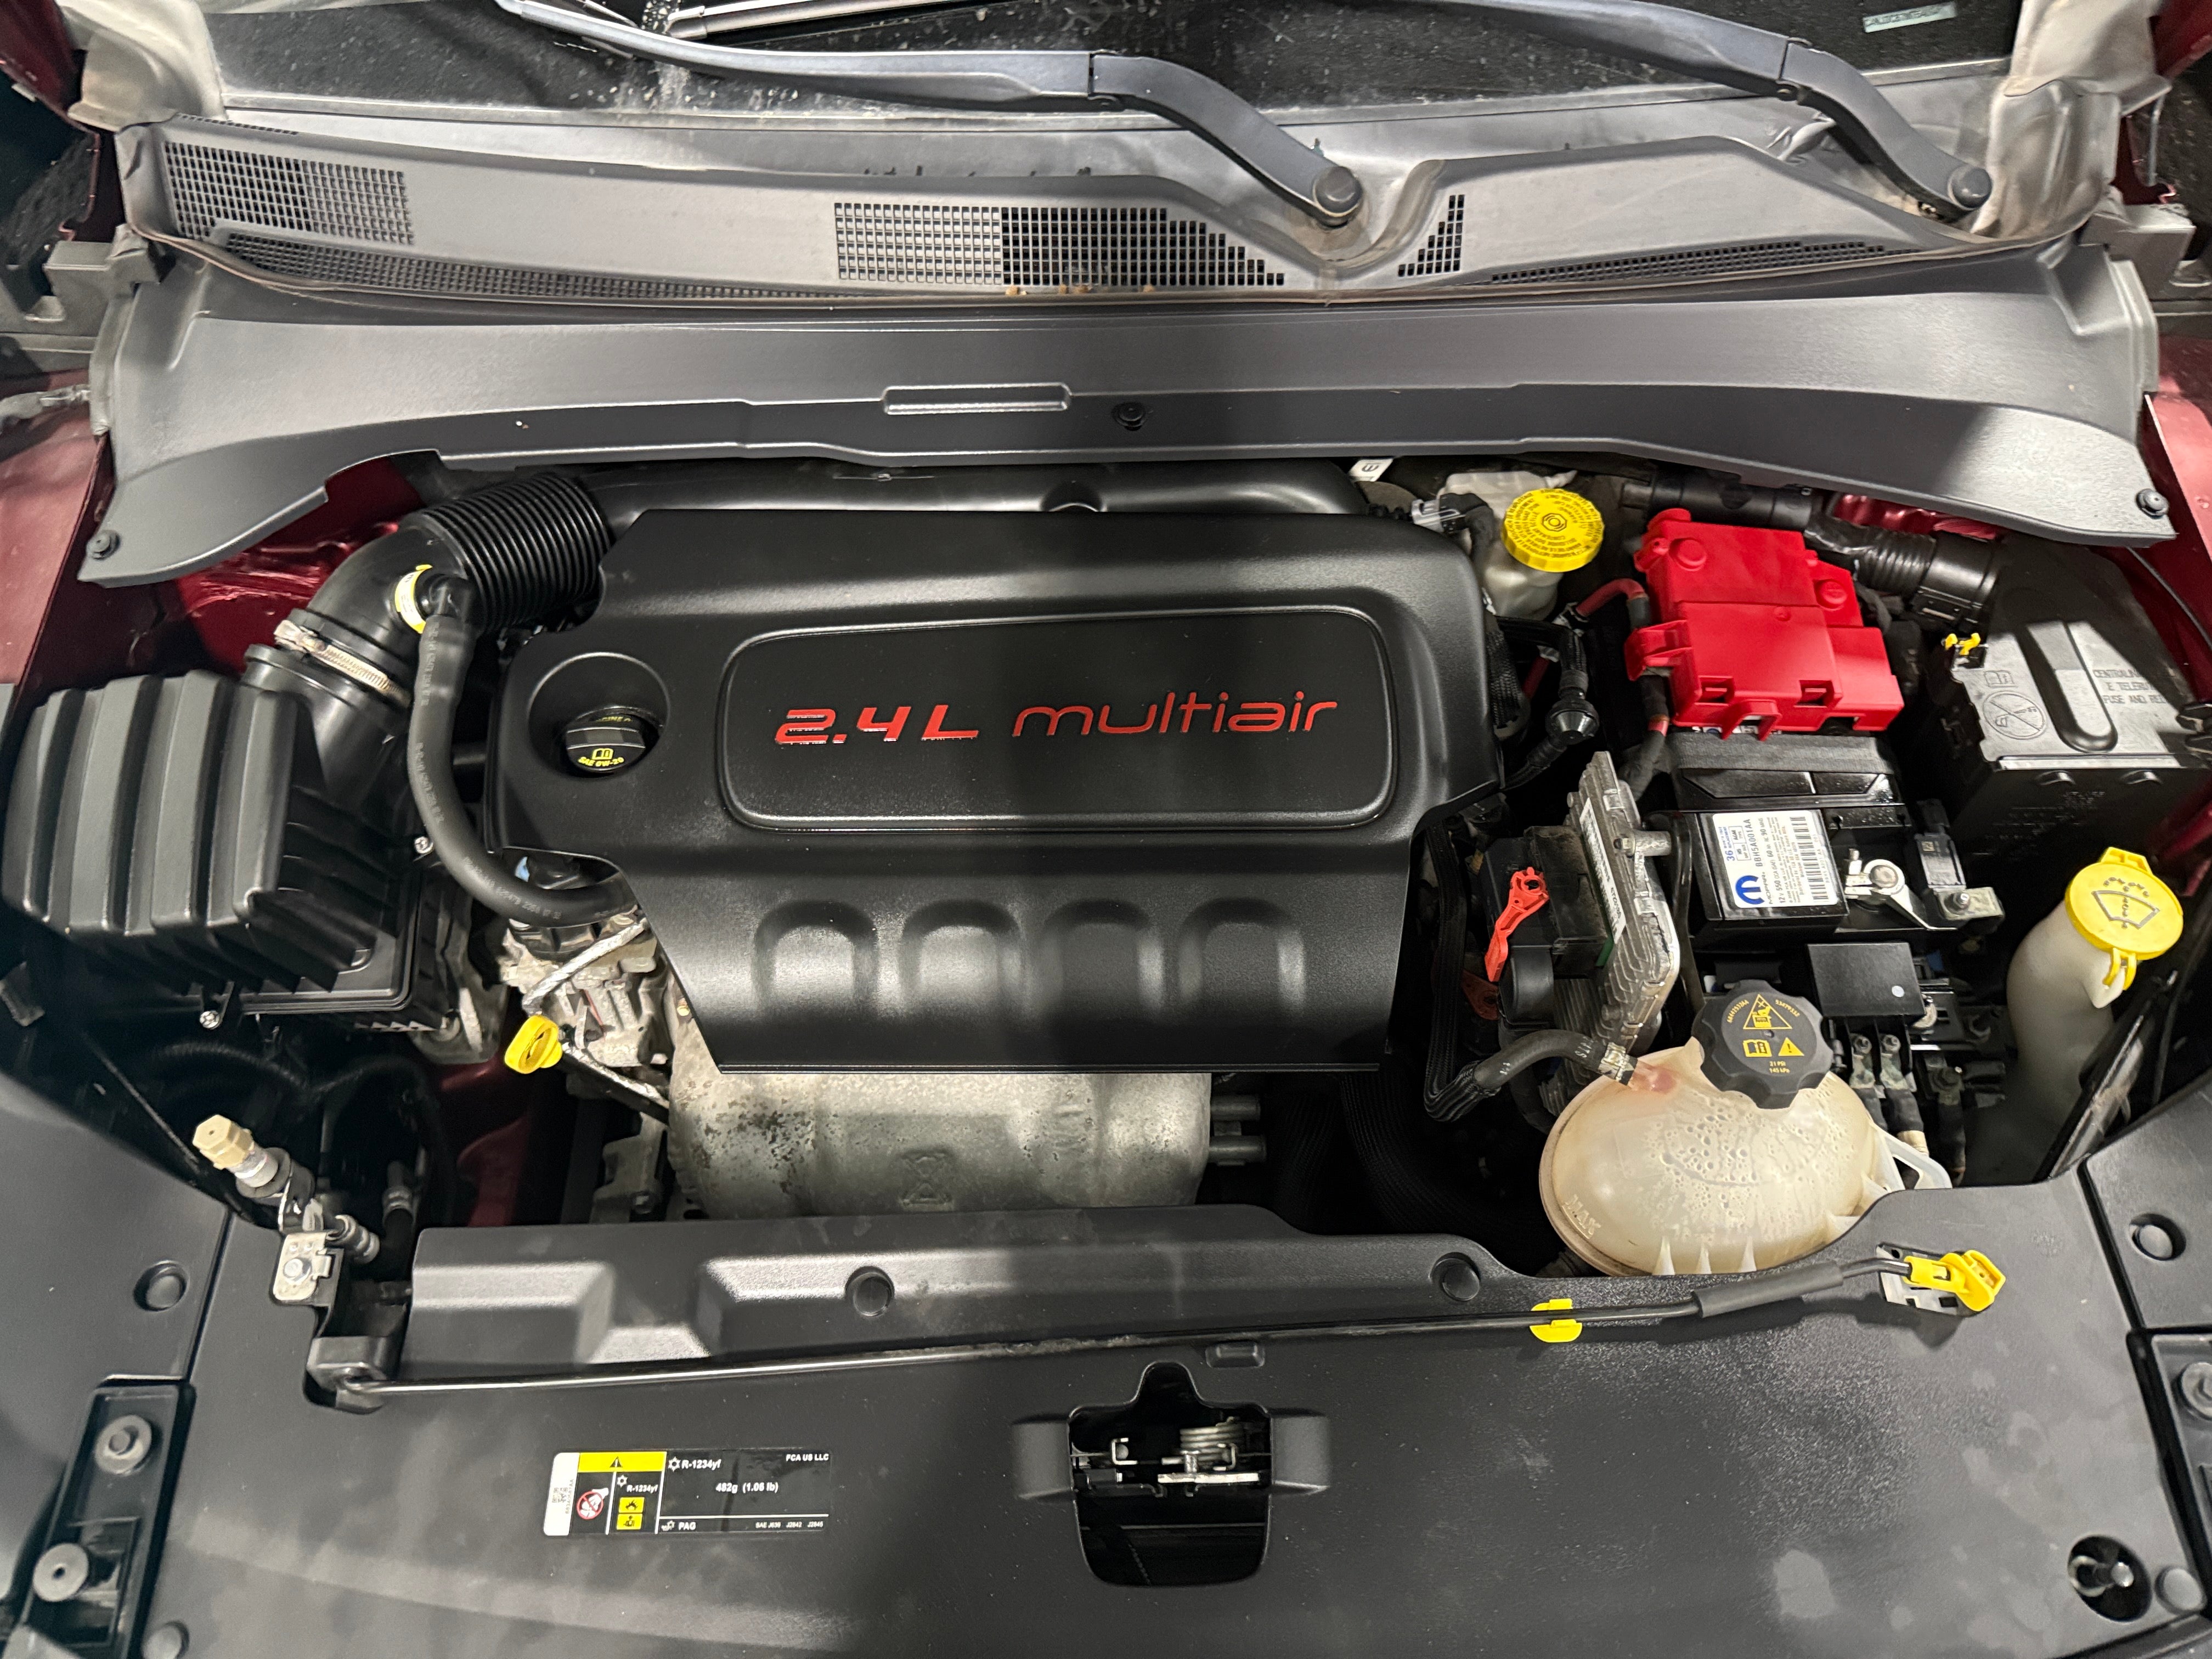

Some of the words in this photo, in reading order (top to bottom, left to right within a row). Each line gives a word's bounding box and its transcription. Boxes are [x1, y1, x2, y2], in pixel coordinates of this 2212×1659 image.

[1012, 691, 1338, 737] multiair
[1725, 850, 1735, 861] 36
[681, 1459, 721, 1471] R-1234yf
[627, 1484, 658, 1493] R-1234yf
[716, 1482, 738, 1493] 482g
[766, 1482, 778, 1493] lb)
[678, 1521, 696, 1531] PAG
